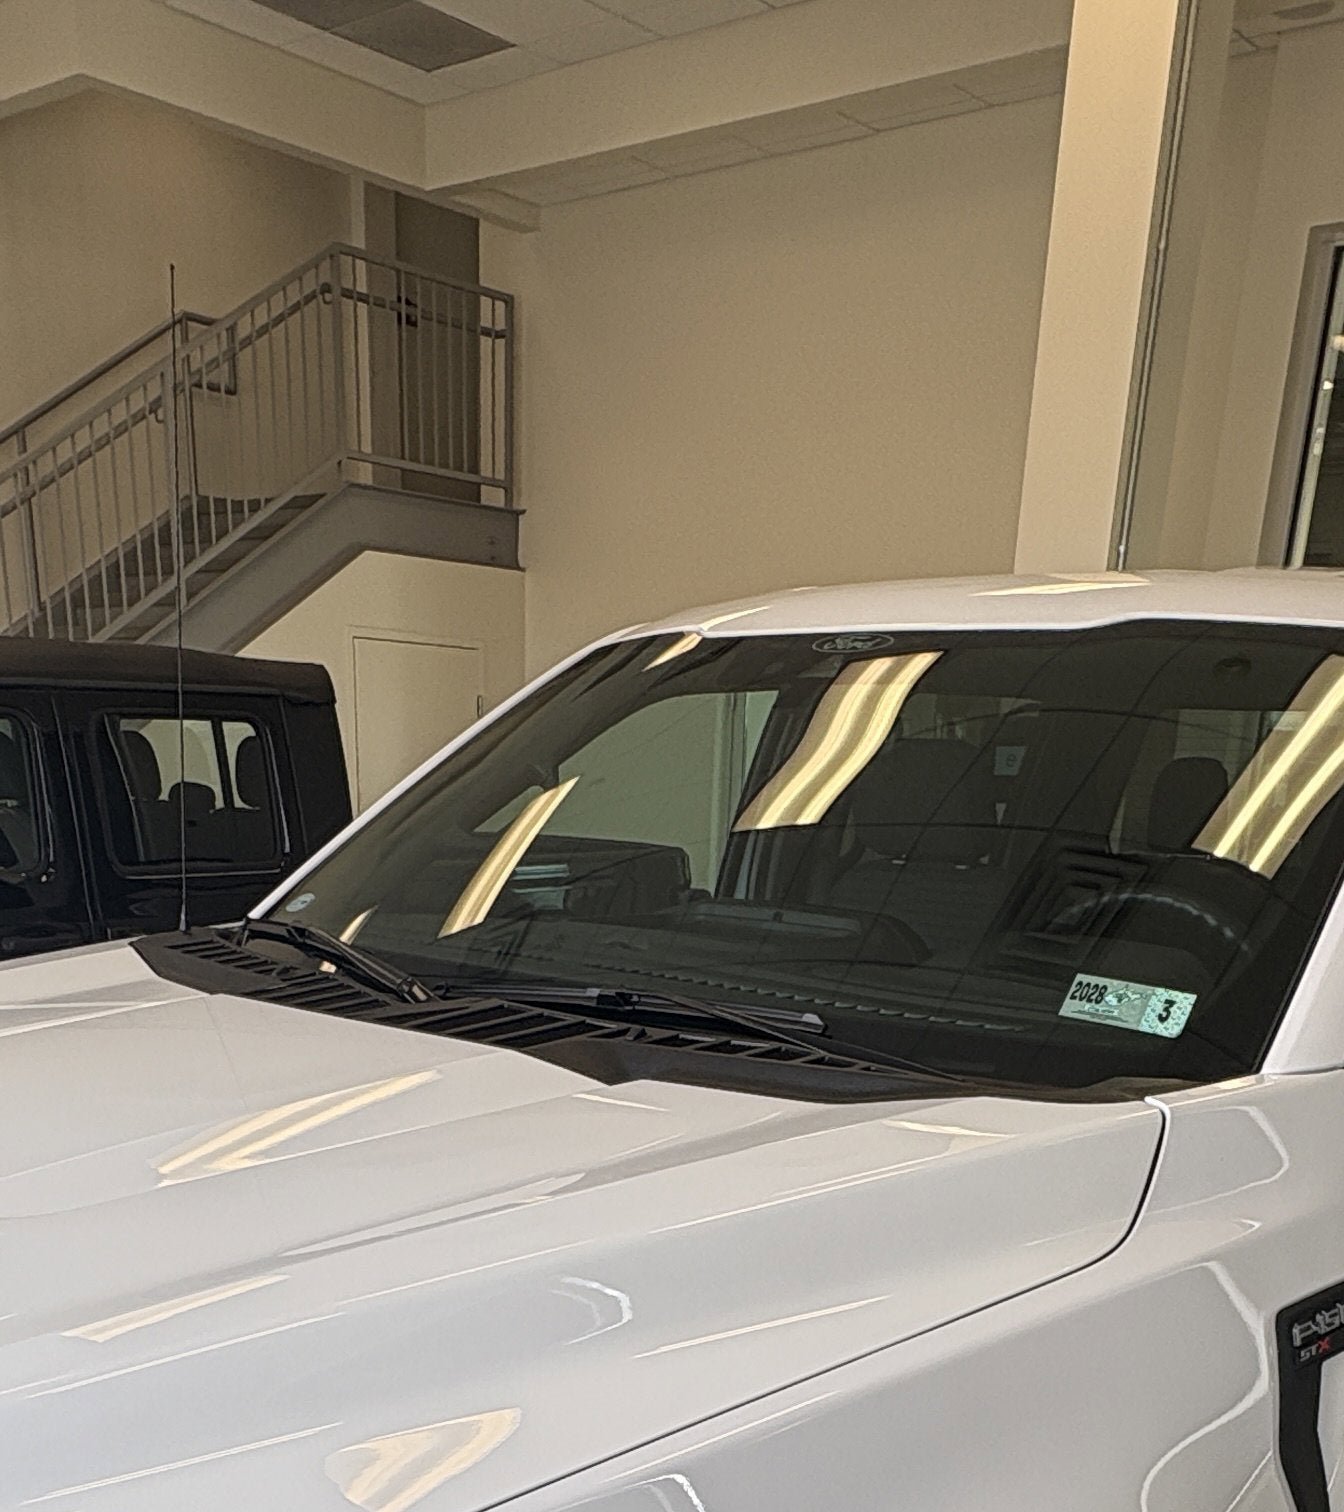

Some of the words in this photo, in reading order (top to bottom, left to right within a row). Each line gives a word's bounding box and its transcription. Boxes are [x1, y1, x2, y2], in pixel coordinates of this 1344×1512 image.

[1069, 981, 1108, 1005] 2028
[1157, 999, 1177, 1024] 3
[1300, 1336, 1331, 1362] STX
